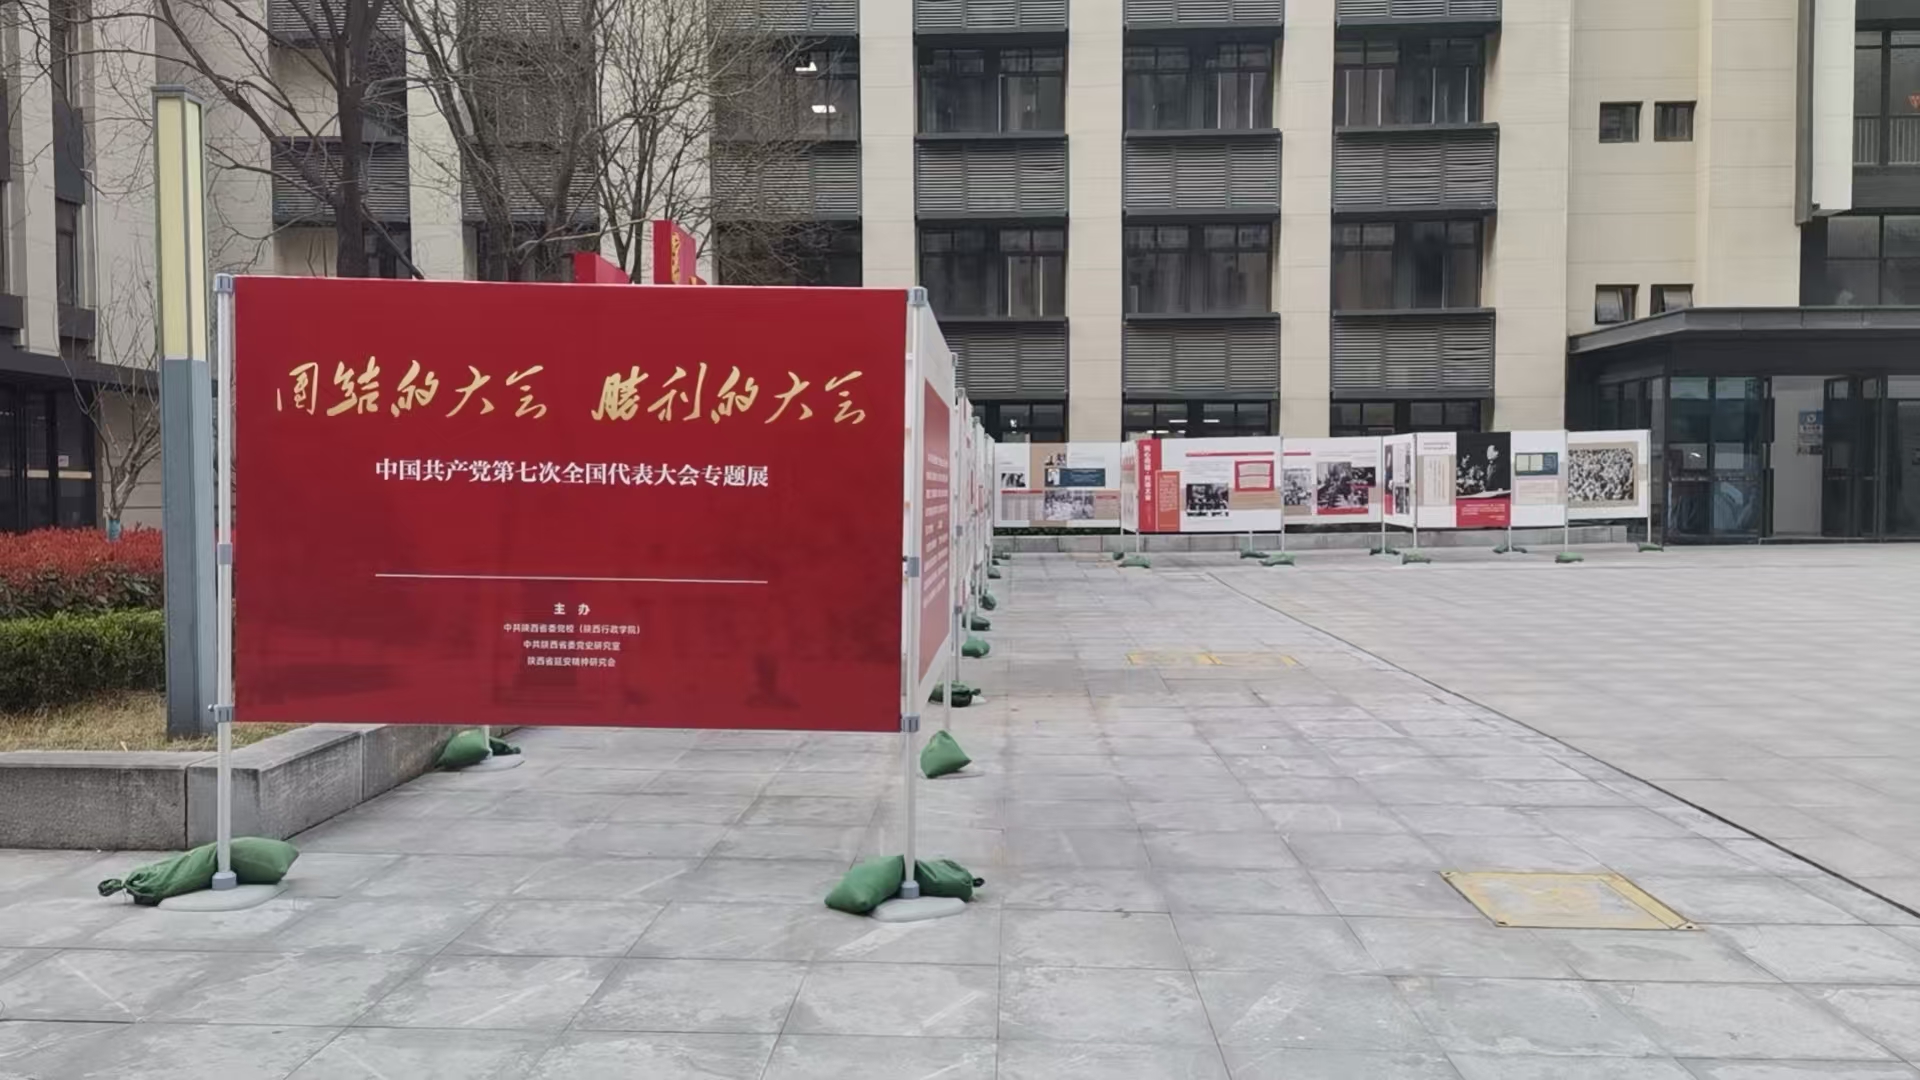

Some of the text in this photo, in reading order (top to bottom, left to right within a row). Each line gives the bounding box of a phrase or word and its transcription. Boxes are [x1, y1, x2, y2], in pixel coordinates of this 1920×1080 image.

[375, 457, 769, 488] 中国共产党第七次全国代表大会专题展
